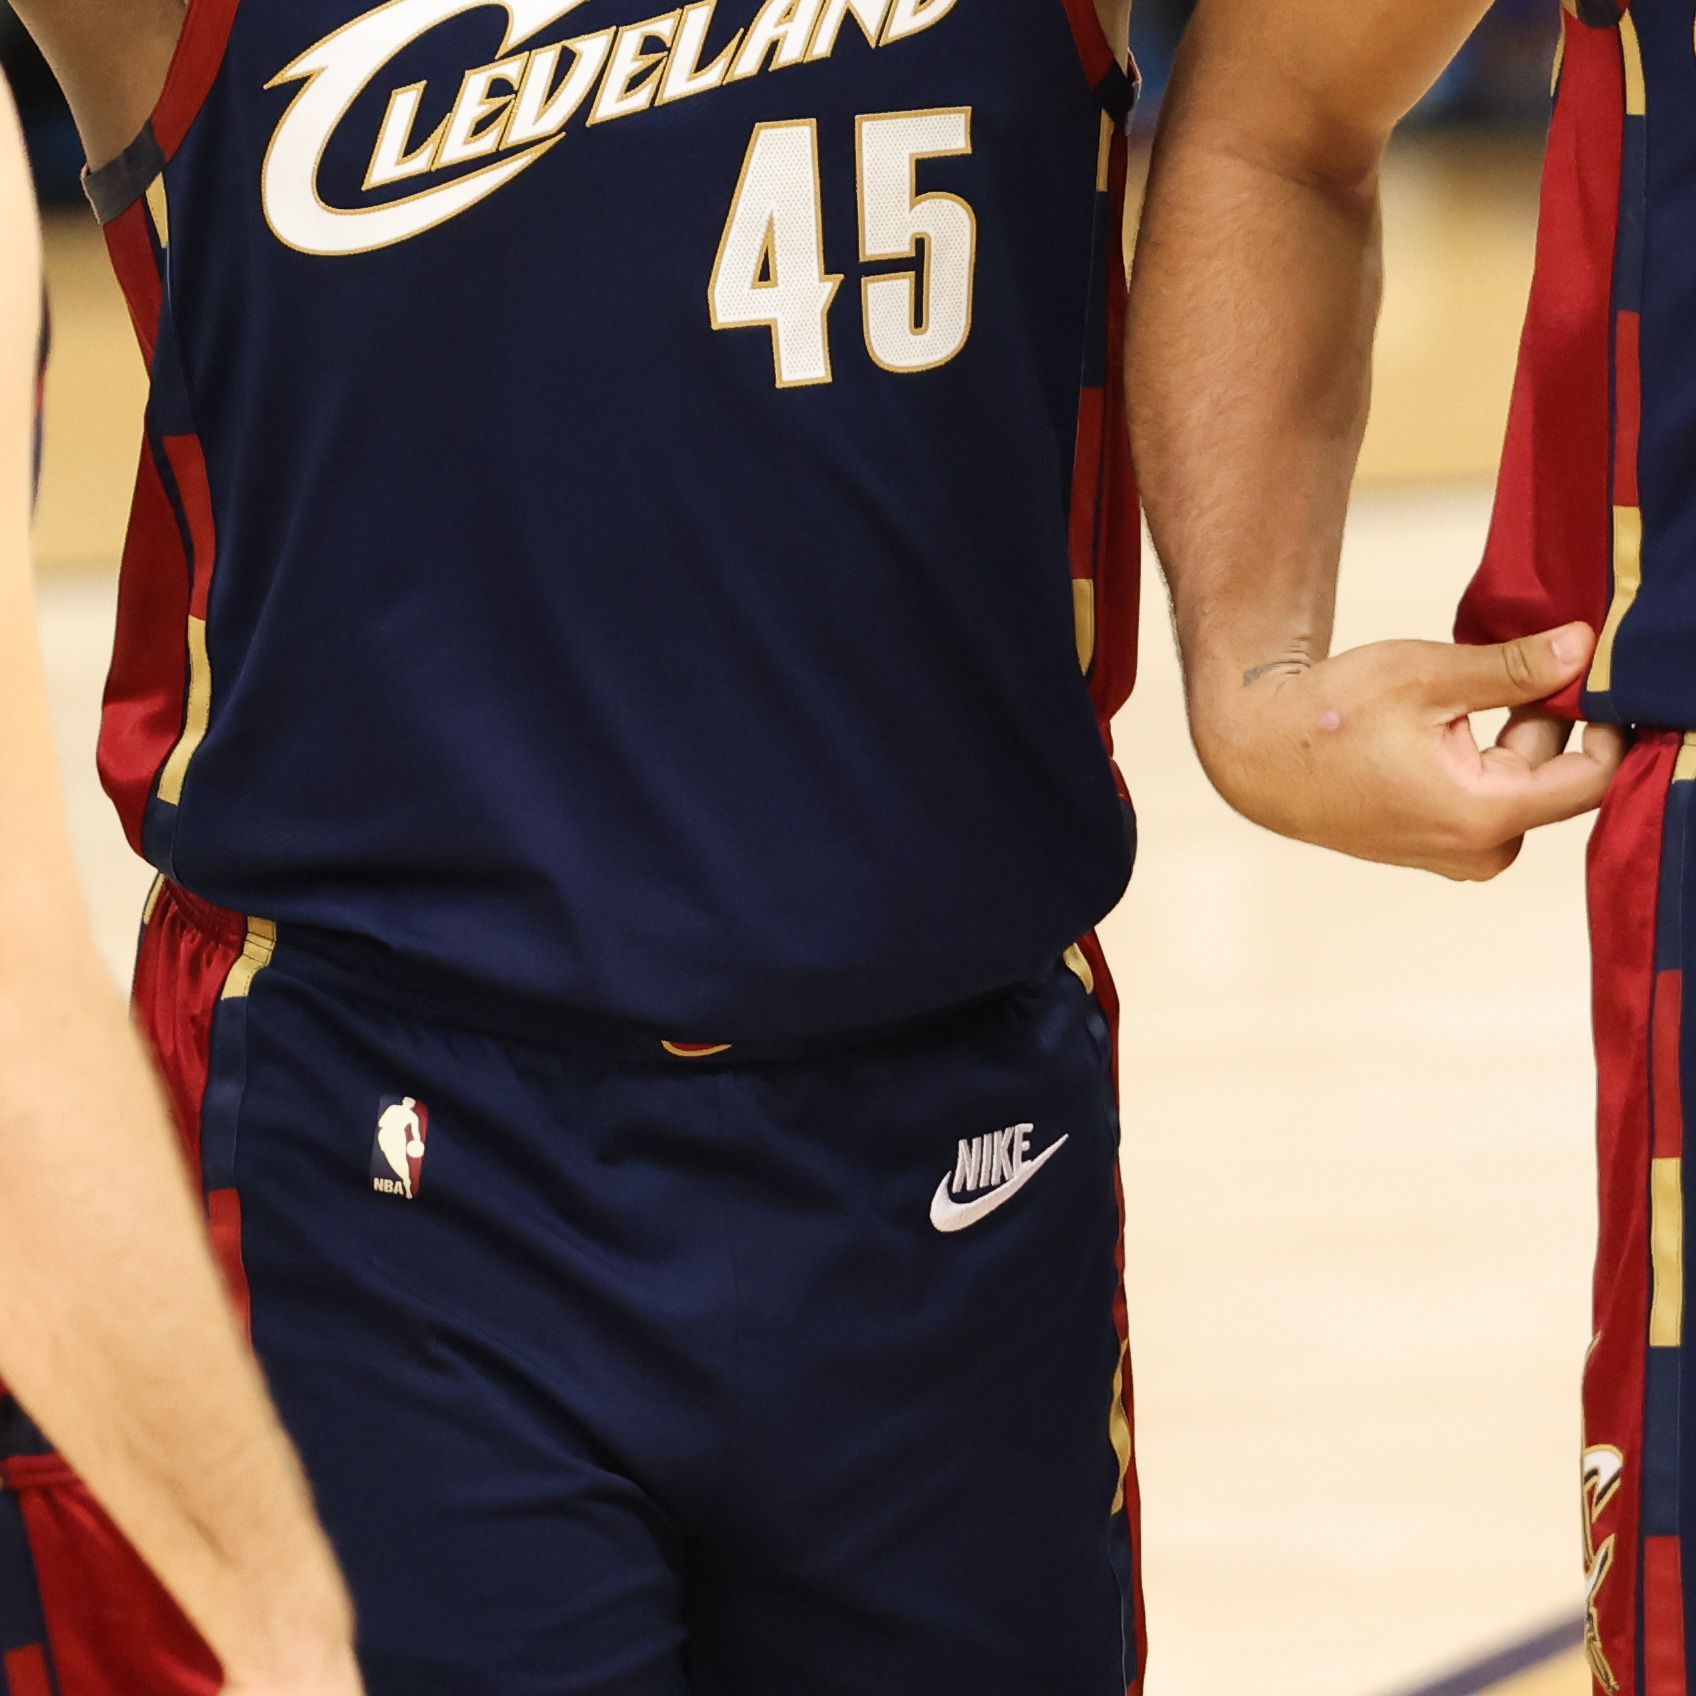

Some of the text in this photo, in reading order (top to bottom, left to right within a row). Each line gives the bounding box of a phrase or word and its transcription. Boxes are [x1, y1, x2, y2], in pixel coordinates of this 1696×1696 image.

[707, 105, 977, 390] 45
[372, 1176, 405, 1196] NBA
[952, 1122, 1035, 1194] NIKE
